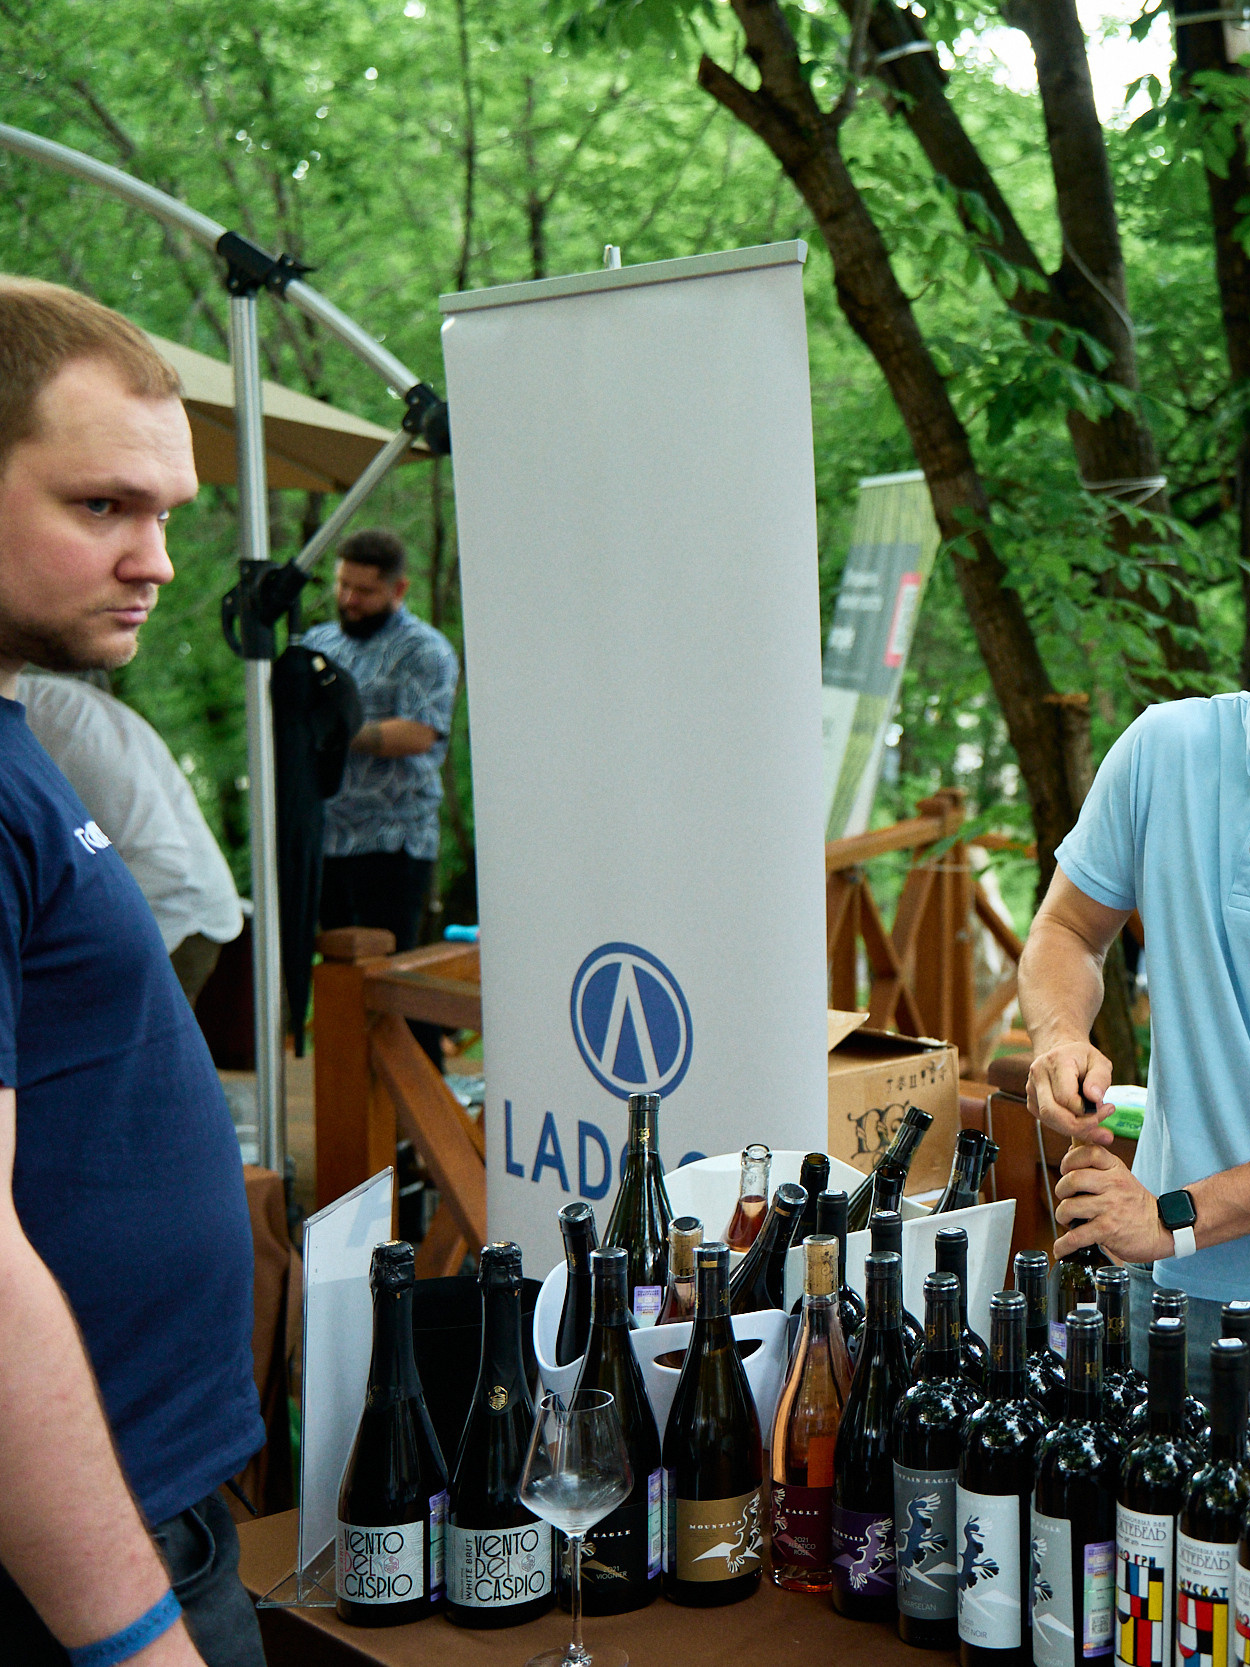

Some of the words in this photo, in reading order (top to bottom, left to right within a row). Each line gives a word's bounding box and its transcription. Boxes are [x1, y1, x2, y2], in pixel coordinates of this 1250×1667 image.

[785, 1507, 819, 1516] EAGLE
[593, 1529, 631, 1538] EAGLE
[689, 1520, 742, 1530] MOUNTAIN
[344, 1528, 404, 1555] VENTO
[465, 1537, 473, 1565] BRUT
[474, 1529, 539, 1558] VENTO
[344, 1550, 376, 1577] DEL
[475, 1556, 514, 1580] DEL
[595, 1570, 628, 1580] VIOGNIER
[344, 1573, 413, 1599] CASPIO
[465, 1567, 473, 1601] WHITE
[474, 1570, 545, 1602] CASPIO
[1179, 1575, 1229, 1598] МУСКАТ
[970, 1628, 988, 1639] NOIR
